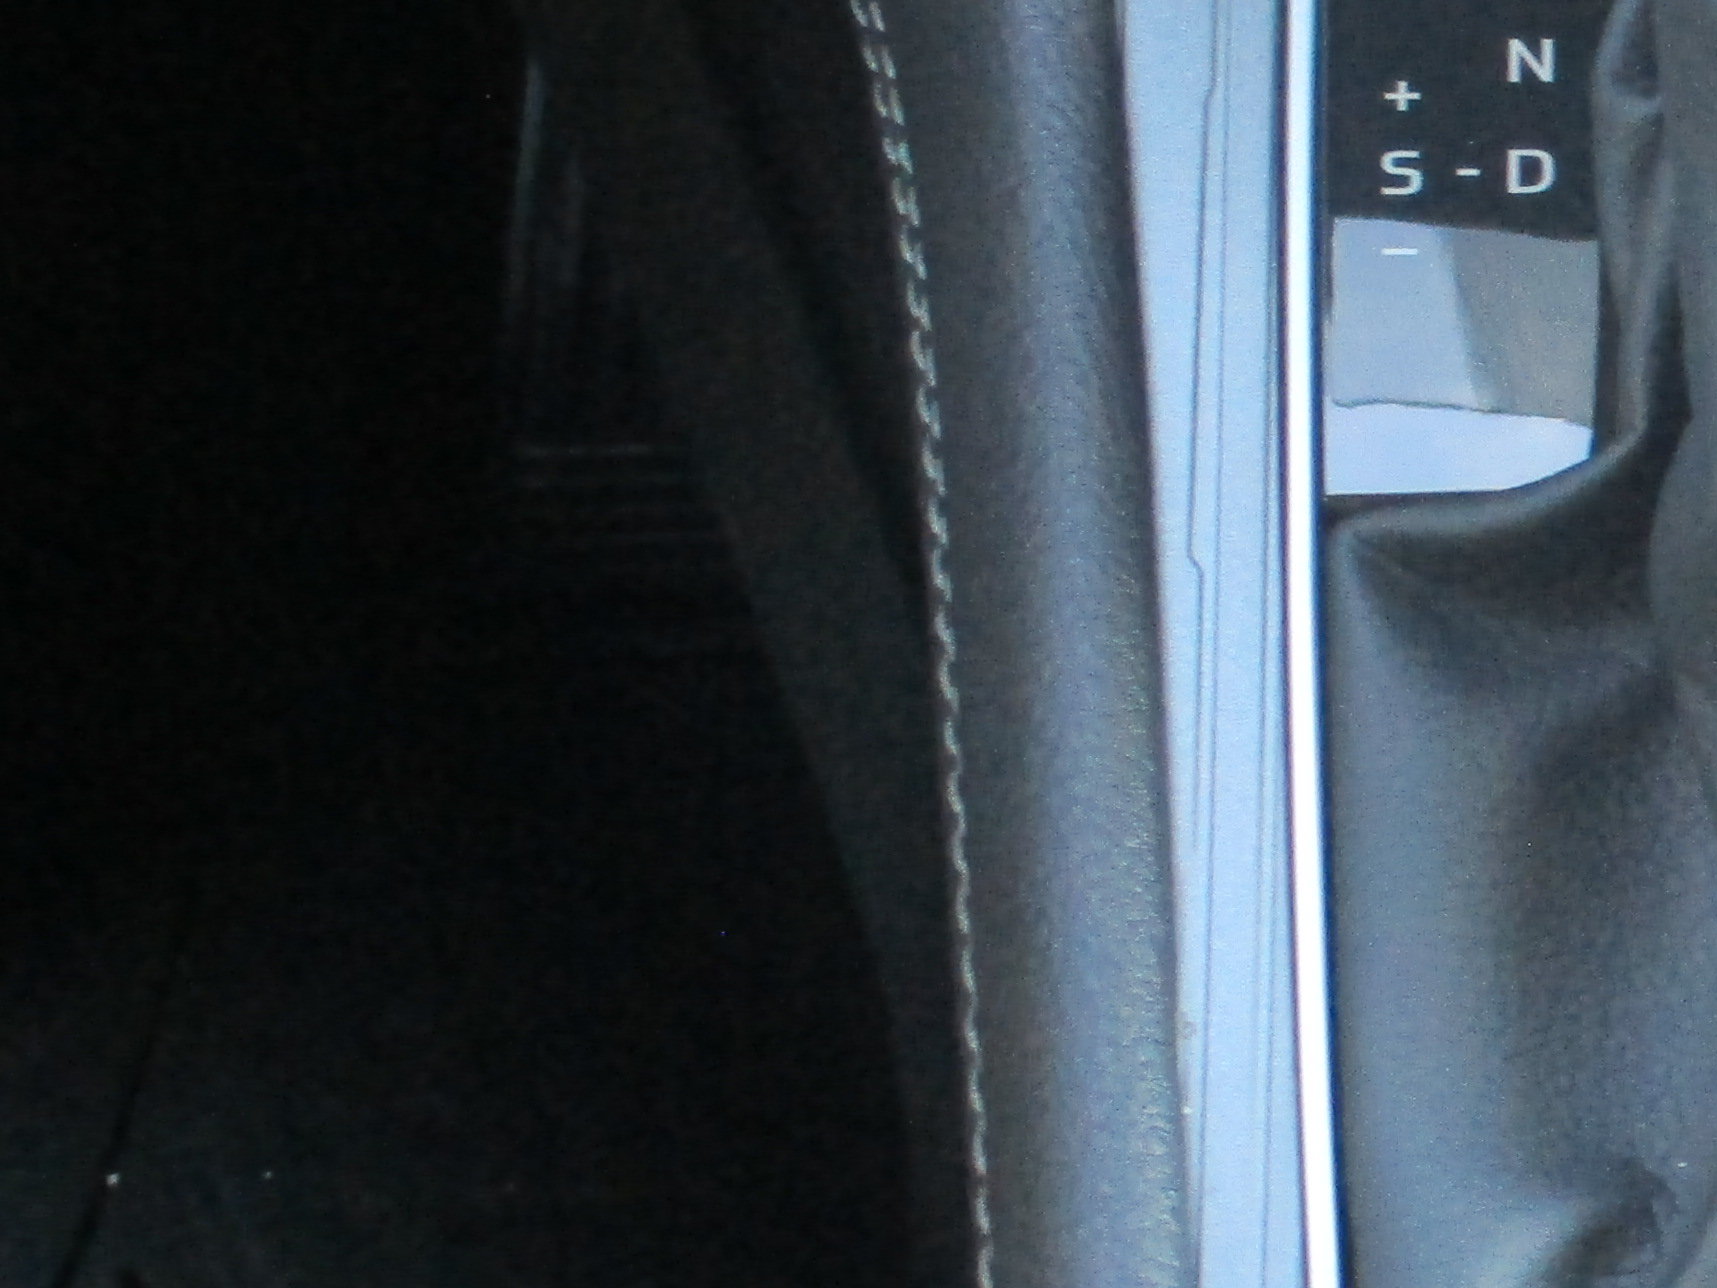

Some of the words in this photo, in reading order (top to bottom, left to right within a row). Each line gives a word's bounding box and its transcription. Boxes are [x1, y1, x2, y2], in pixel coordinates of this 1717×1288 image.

[1505, 37, 1556, 85] N
[1378, 149, 1424, 197] S
[1505, 149, 1556, 195] D
